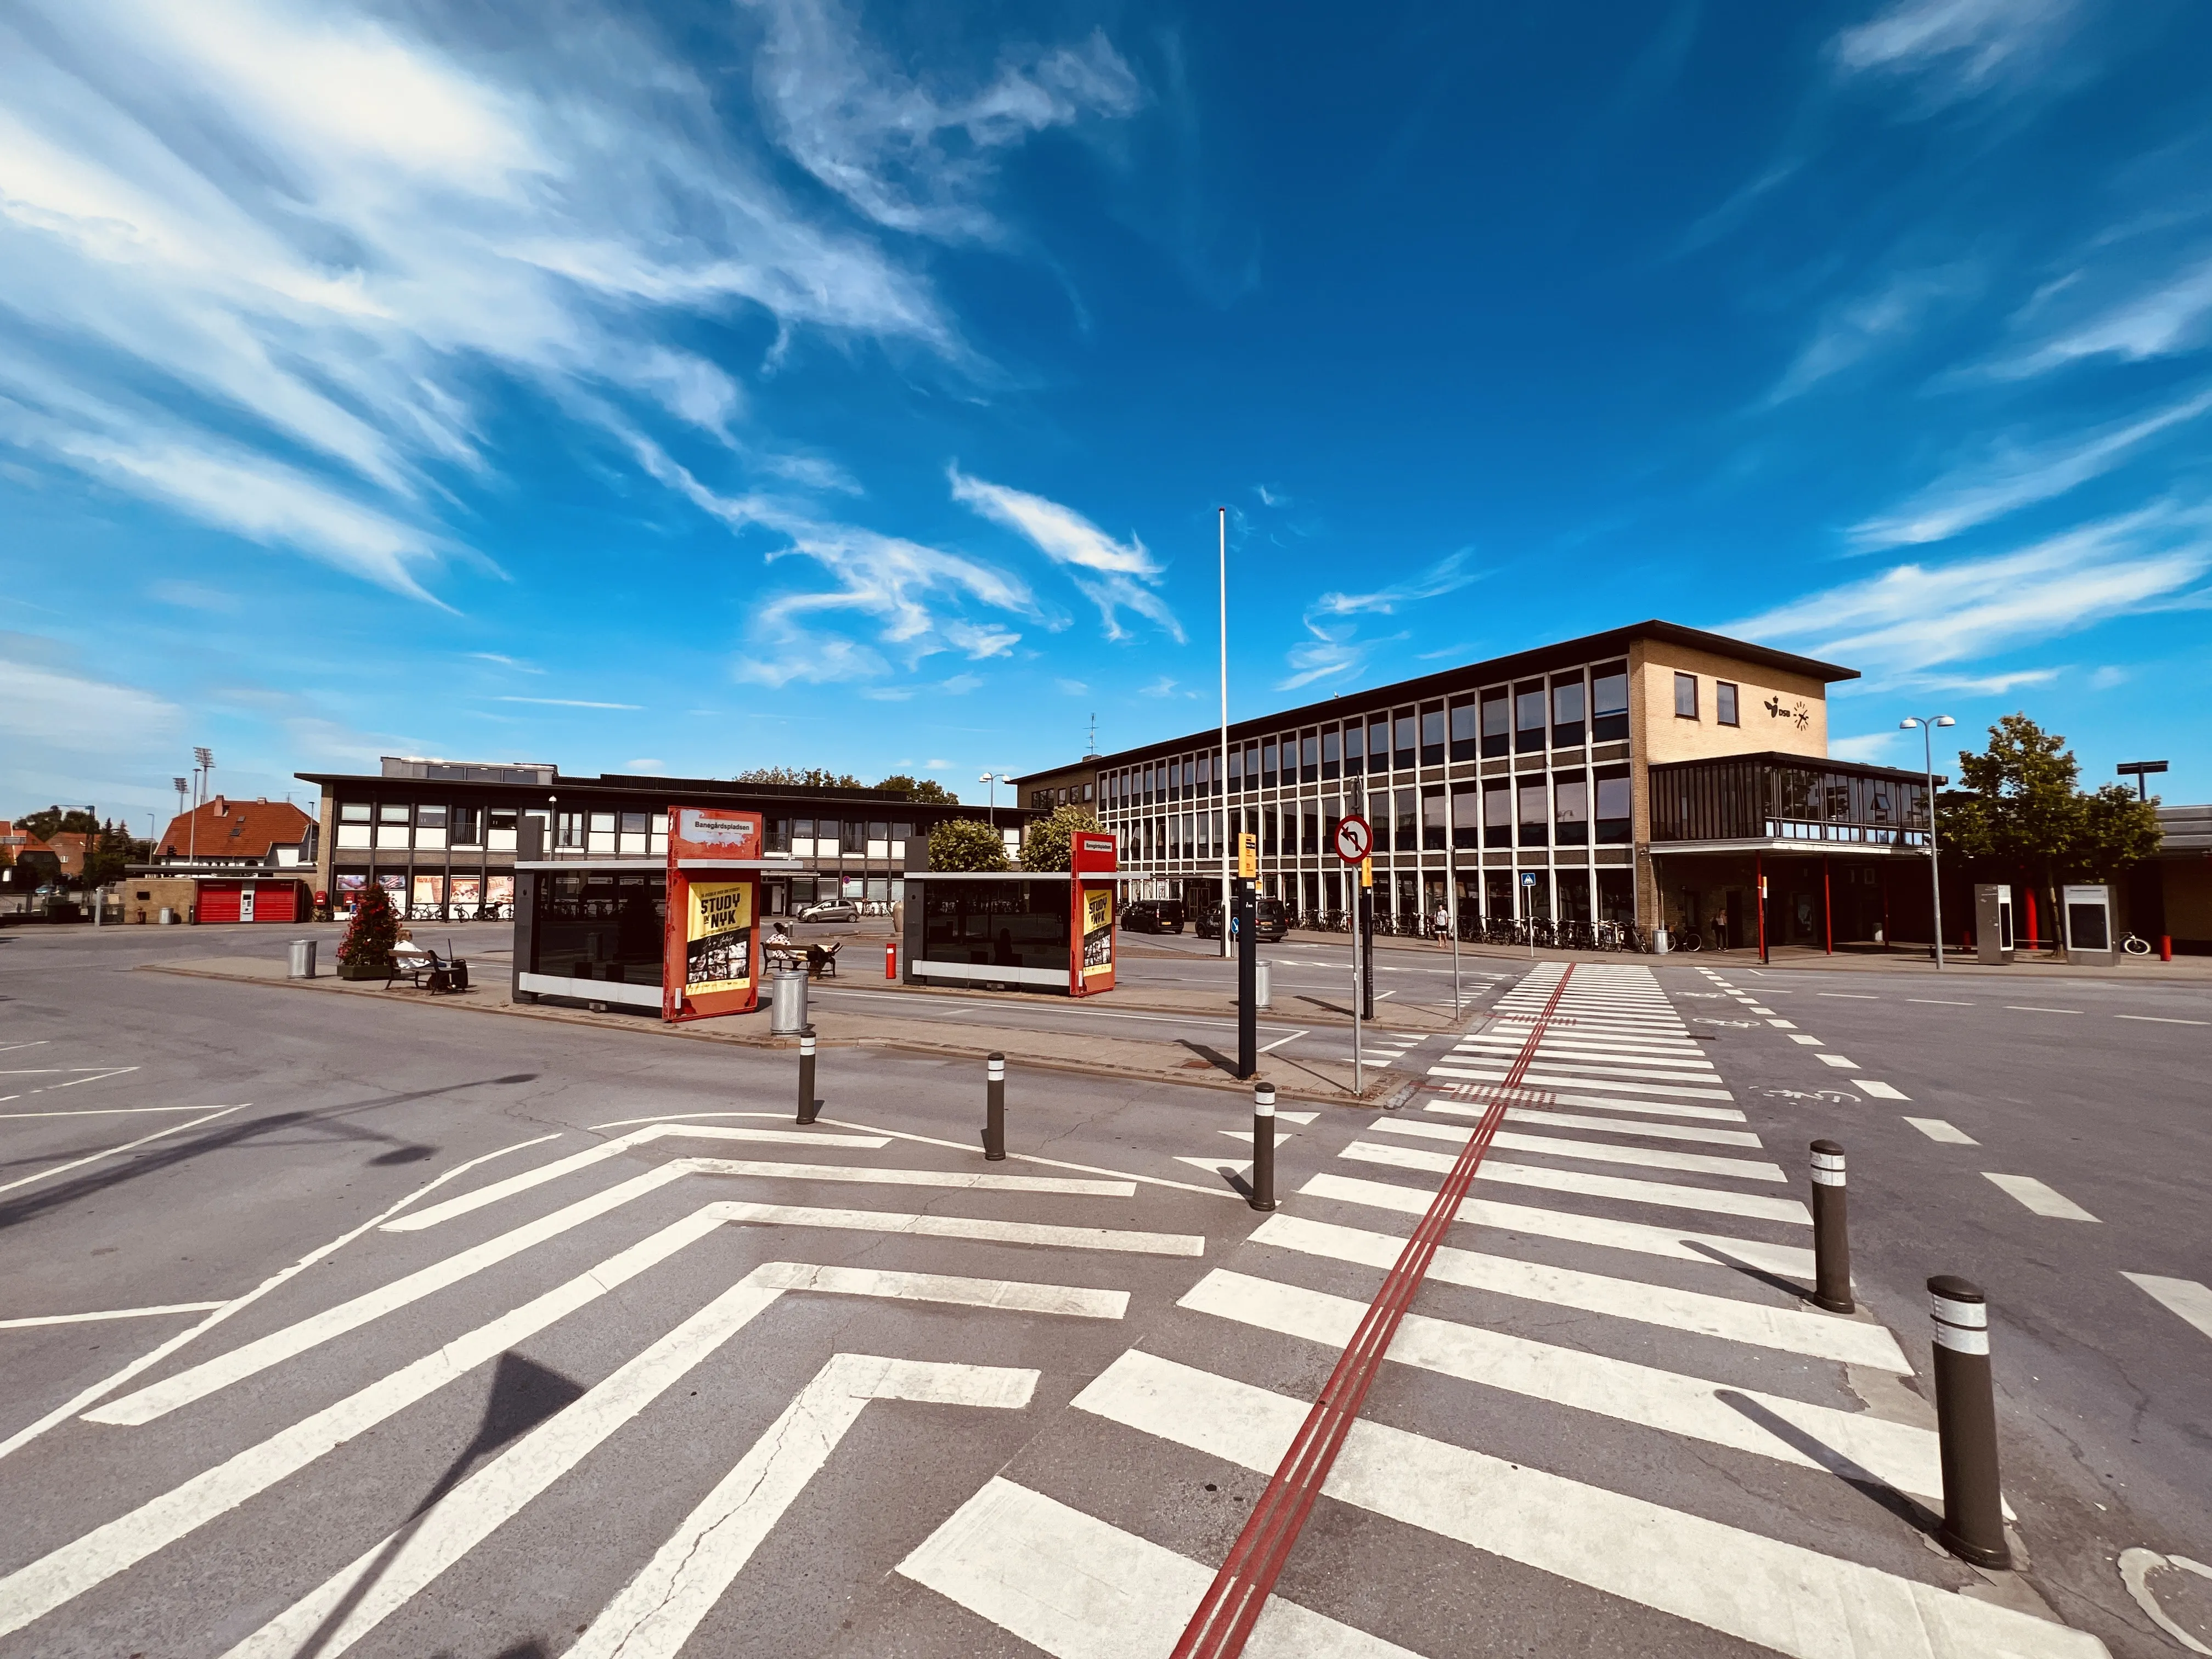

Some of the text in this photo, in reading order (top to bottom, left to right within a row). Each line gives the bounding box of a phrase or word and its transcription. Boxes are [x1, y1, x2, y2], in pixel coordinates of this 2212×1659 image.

[1779, 709, 1790, 717] DSB
[695, 821, 750, 831] Banegårdspladsen
[701, 893, 741, 914] STUDY
[1089, 897, 1107, 914] STUDY
[711, 910, 736, 928] NYK
[1093, 910, 1105, 924] NYK
